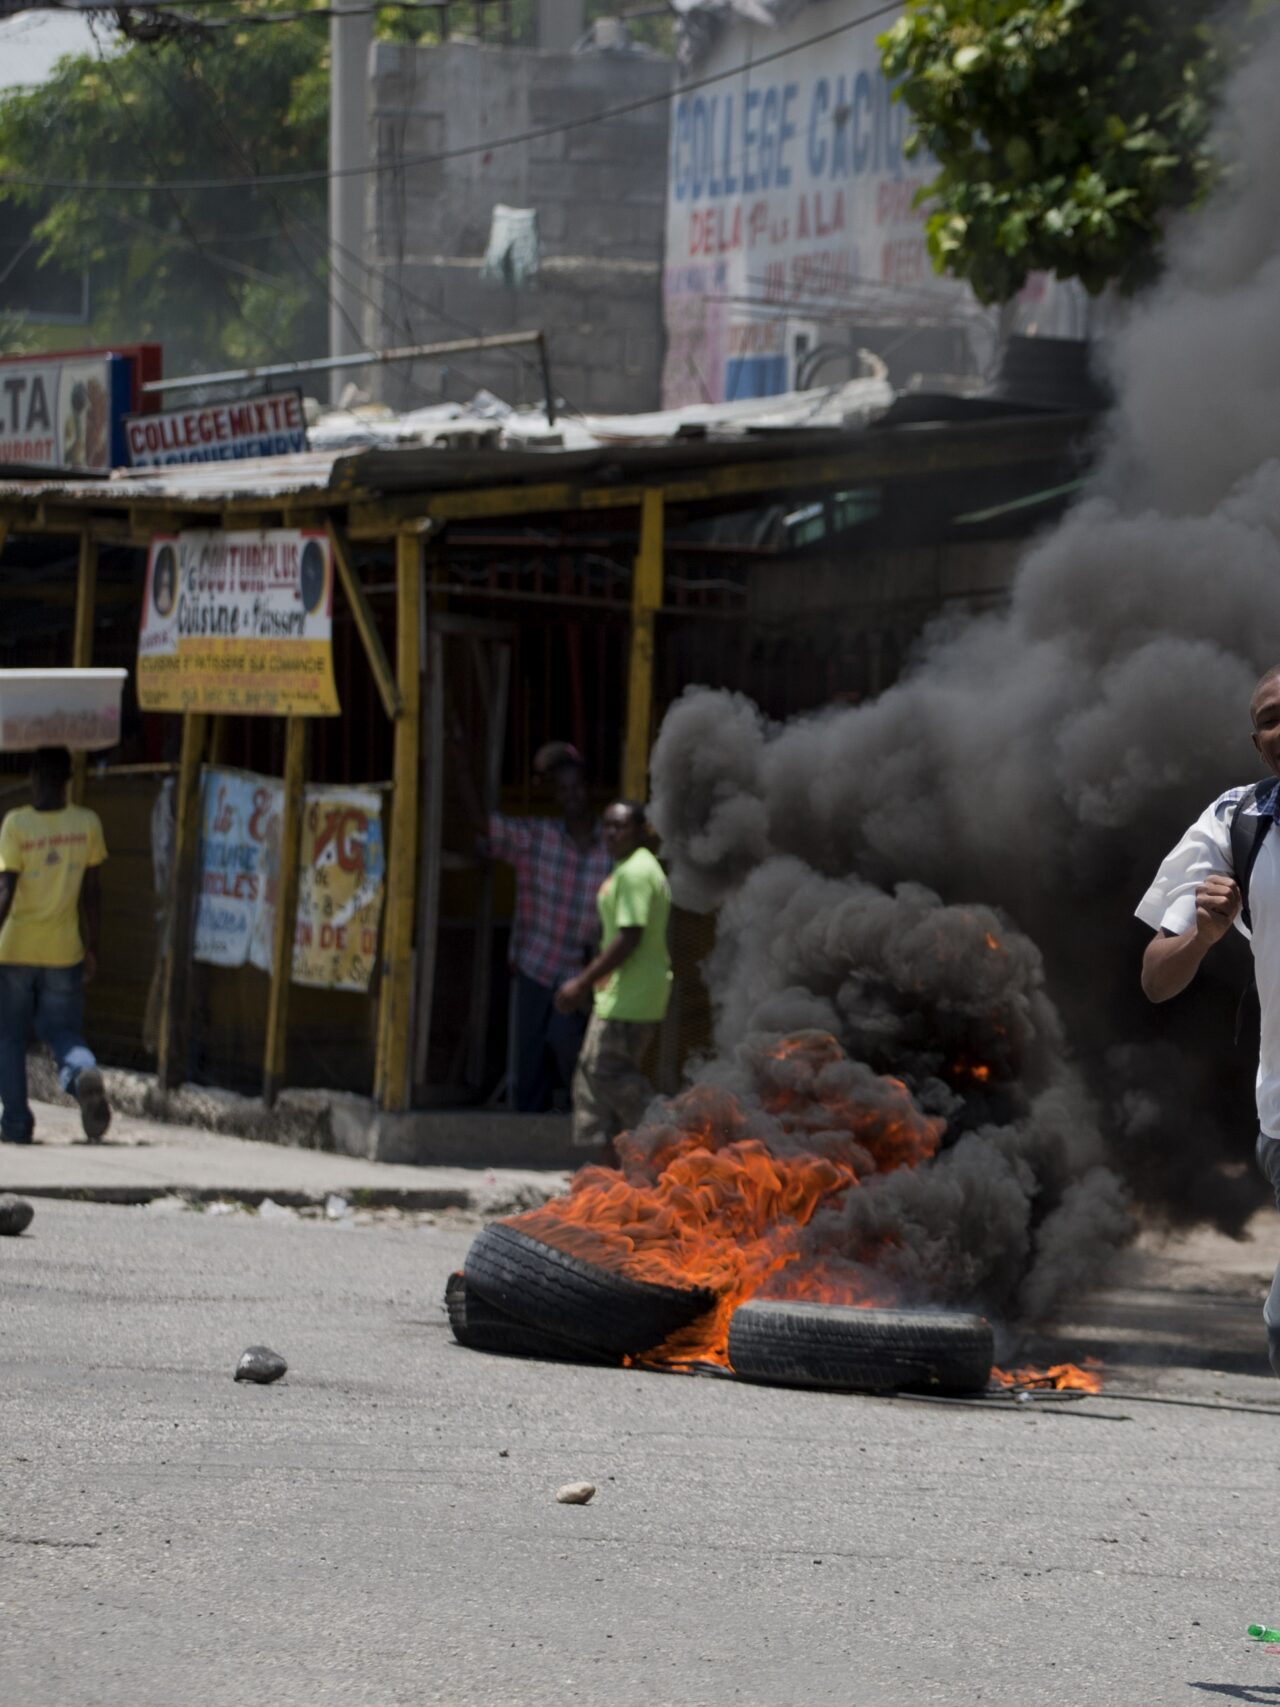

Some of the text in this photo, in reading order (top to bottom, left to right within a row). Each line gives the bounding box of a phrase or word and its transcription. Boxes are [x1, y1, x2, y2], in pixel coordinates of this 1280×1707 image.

[674, 82, 799, 202] COLLEGE
[0, 376, 50, 433] TA
[130, 397, 300, 455] COLLEGE MIXTE
